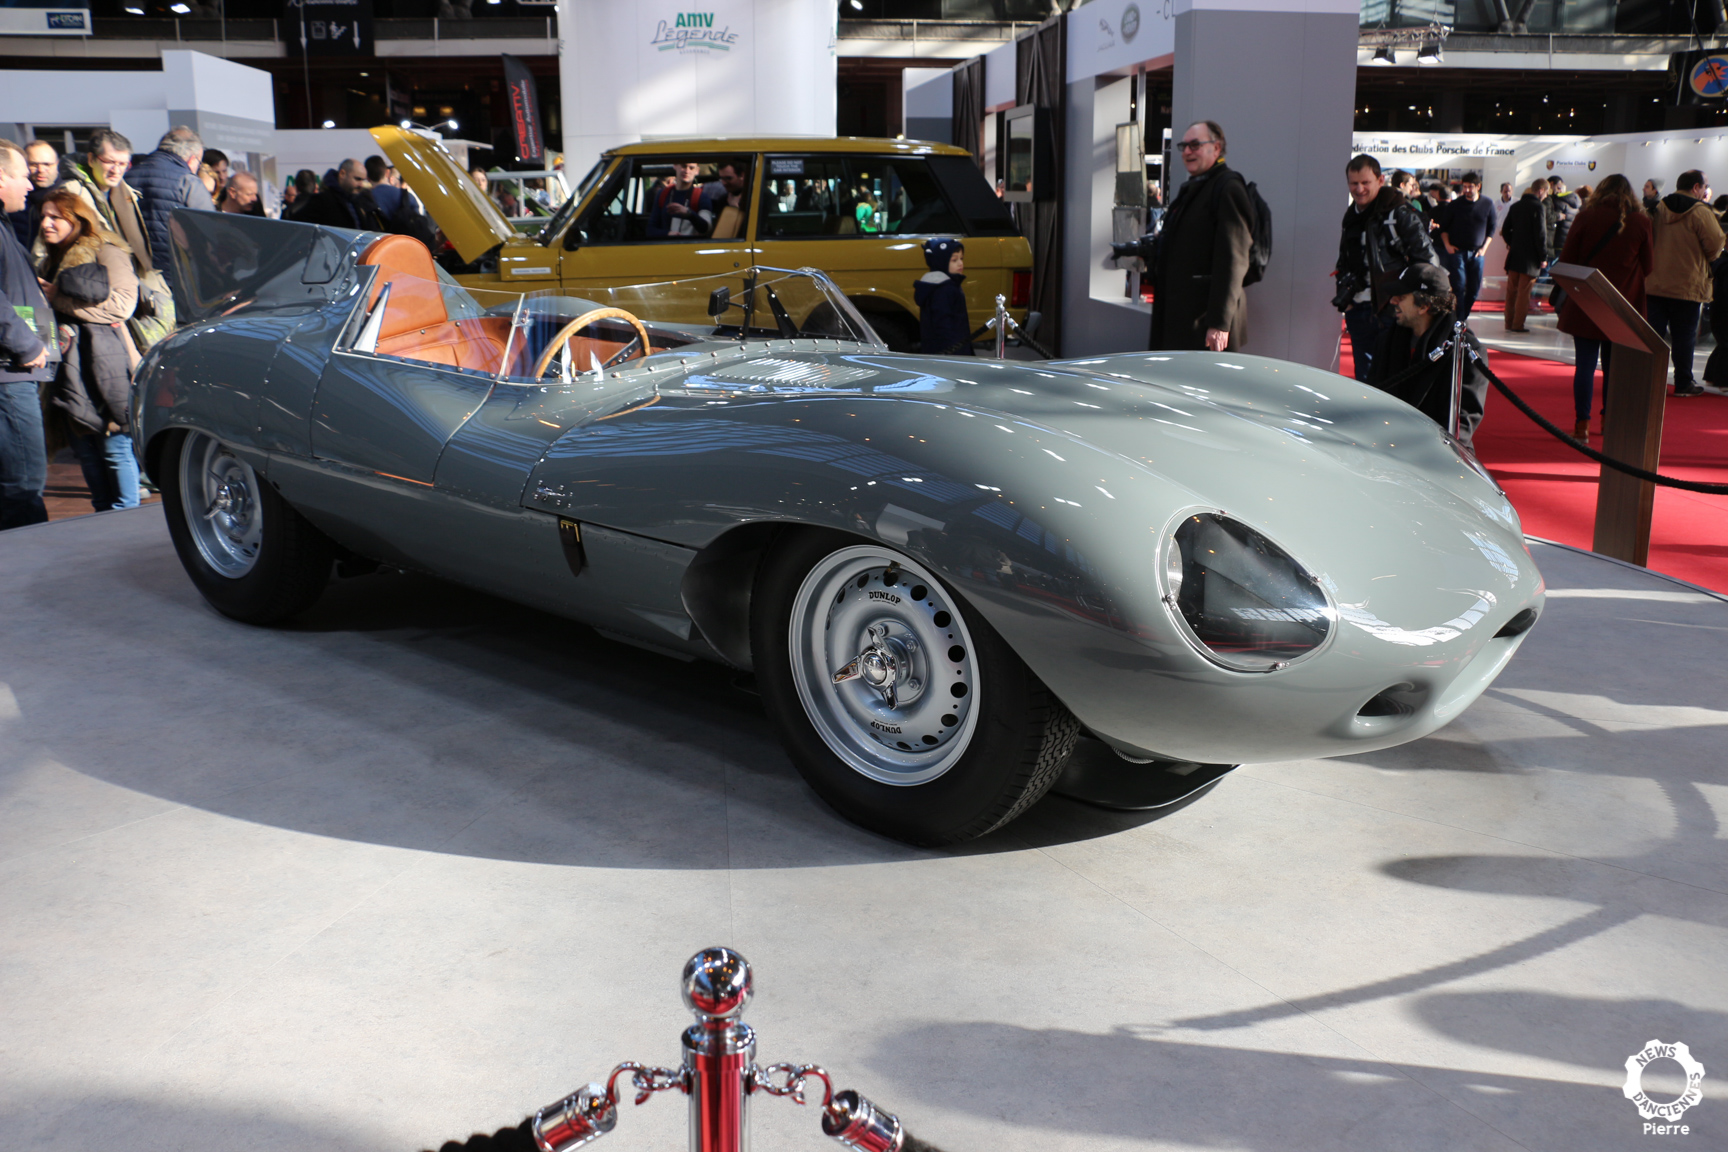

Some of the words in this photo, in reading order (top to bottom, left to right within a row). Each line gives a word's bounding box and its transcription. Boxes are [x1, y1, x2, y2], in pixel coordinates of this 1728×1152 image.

[675, 12, 714, 28] AMV
[650, 20, 739, 49] Légende
[1352, 143, 1389, 153] dération
[1391, 144, 1406, 153] des
[1409, 144, 1434, 154] Clubs
[1436, 145, 1470, 155] Porsche
[1472, 145, 1483, 155] de
[1485, 146, 1515, 156] France
[869, 591, 901, 604] DUNLOP
[870, 720, 902, 734] DUNLOP
